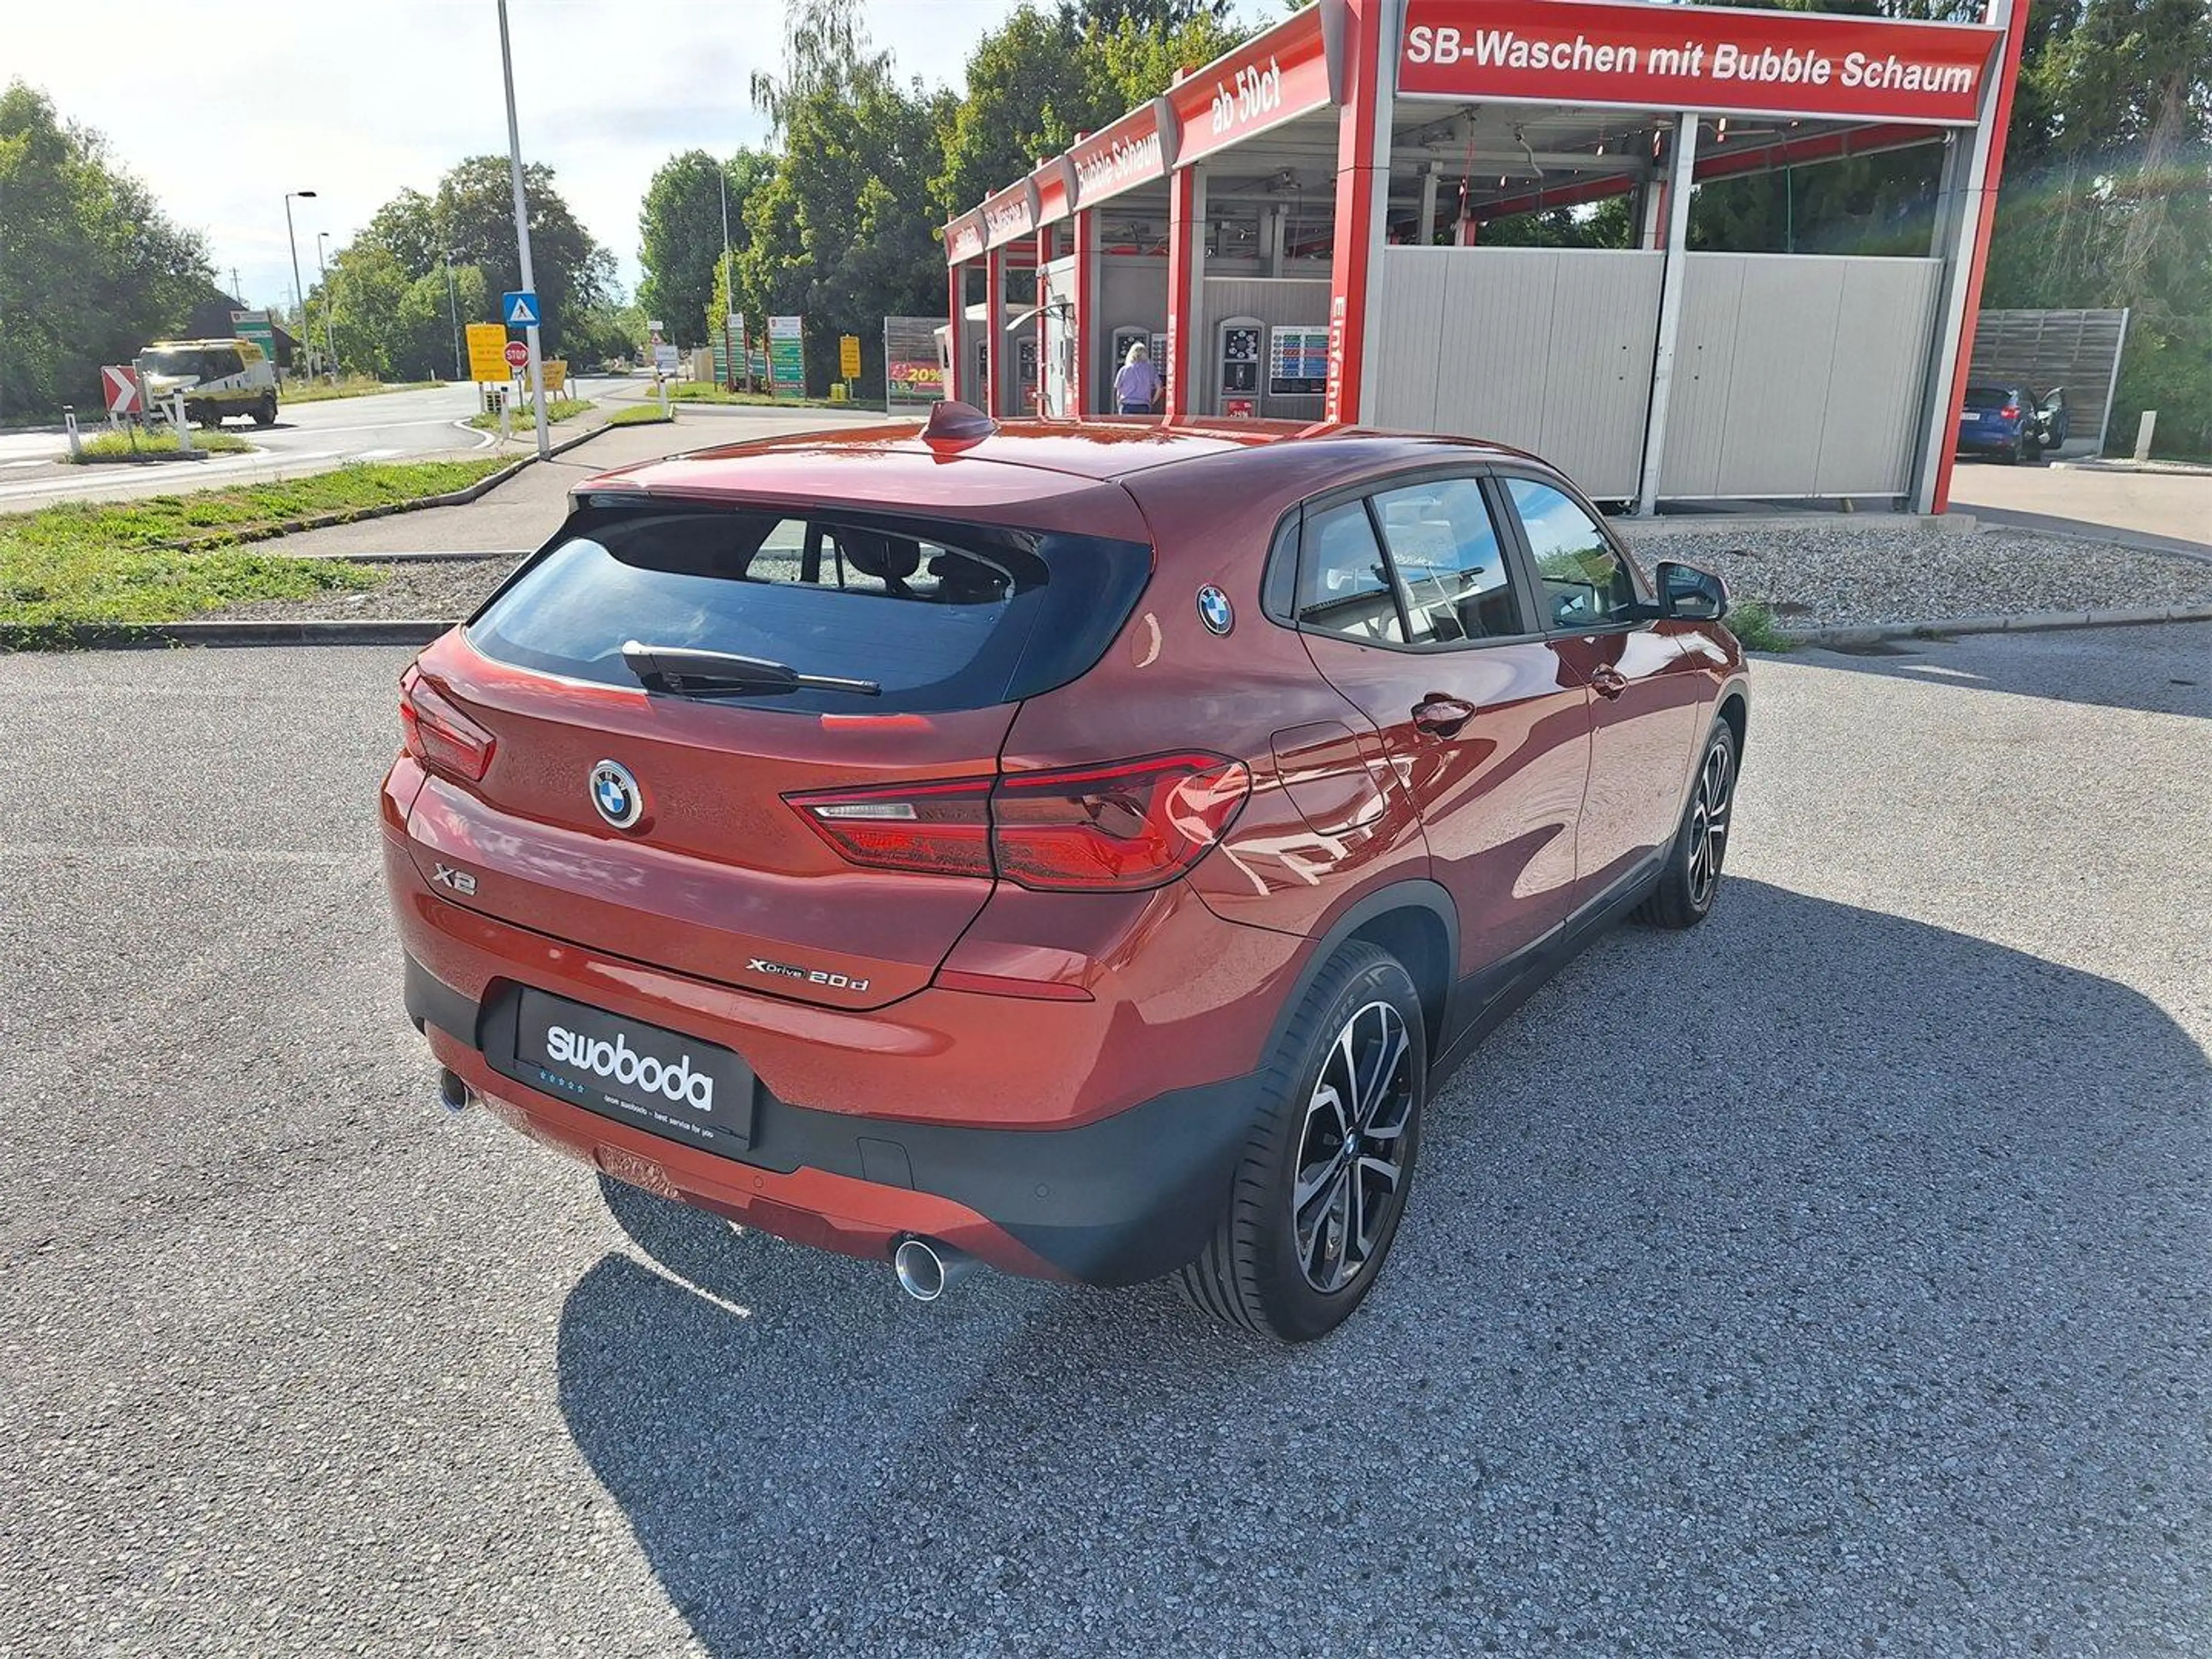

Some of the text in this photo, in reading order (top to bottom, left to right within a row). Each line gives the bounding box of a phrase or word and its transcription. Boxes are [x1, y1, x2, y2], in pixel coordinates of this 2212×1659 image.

[1407, 25, 1972, 93] SB-Waschen mit Bubble Schaum
[1212, 55, 1281, 135] ab 50ct
[1074, 149, 1113, 196] Bubble
[506, 349, 527, 360] STOP
[433, 861, 476, 896] X2
[547, 1025, 714, 1112] swoboda
